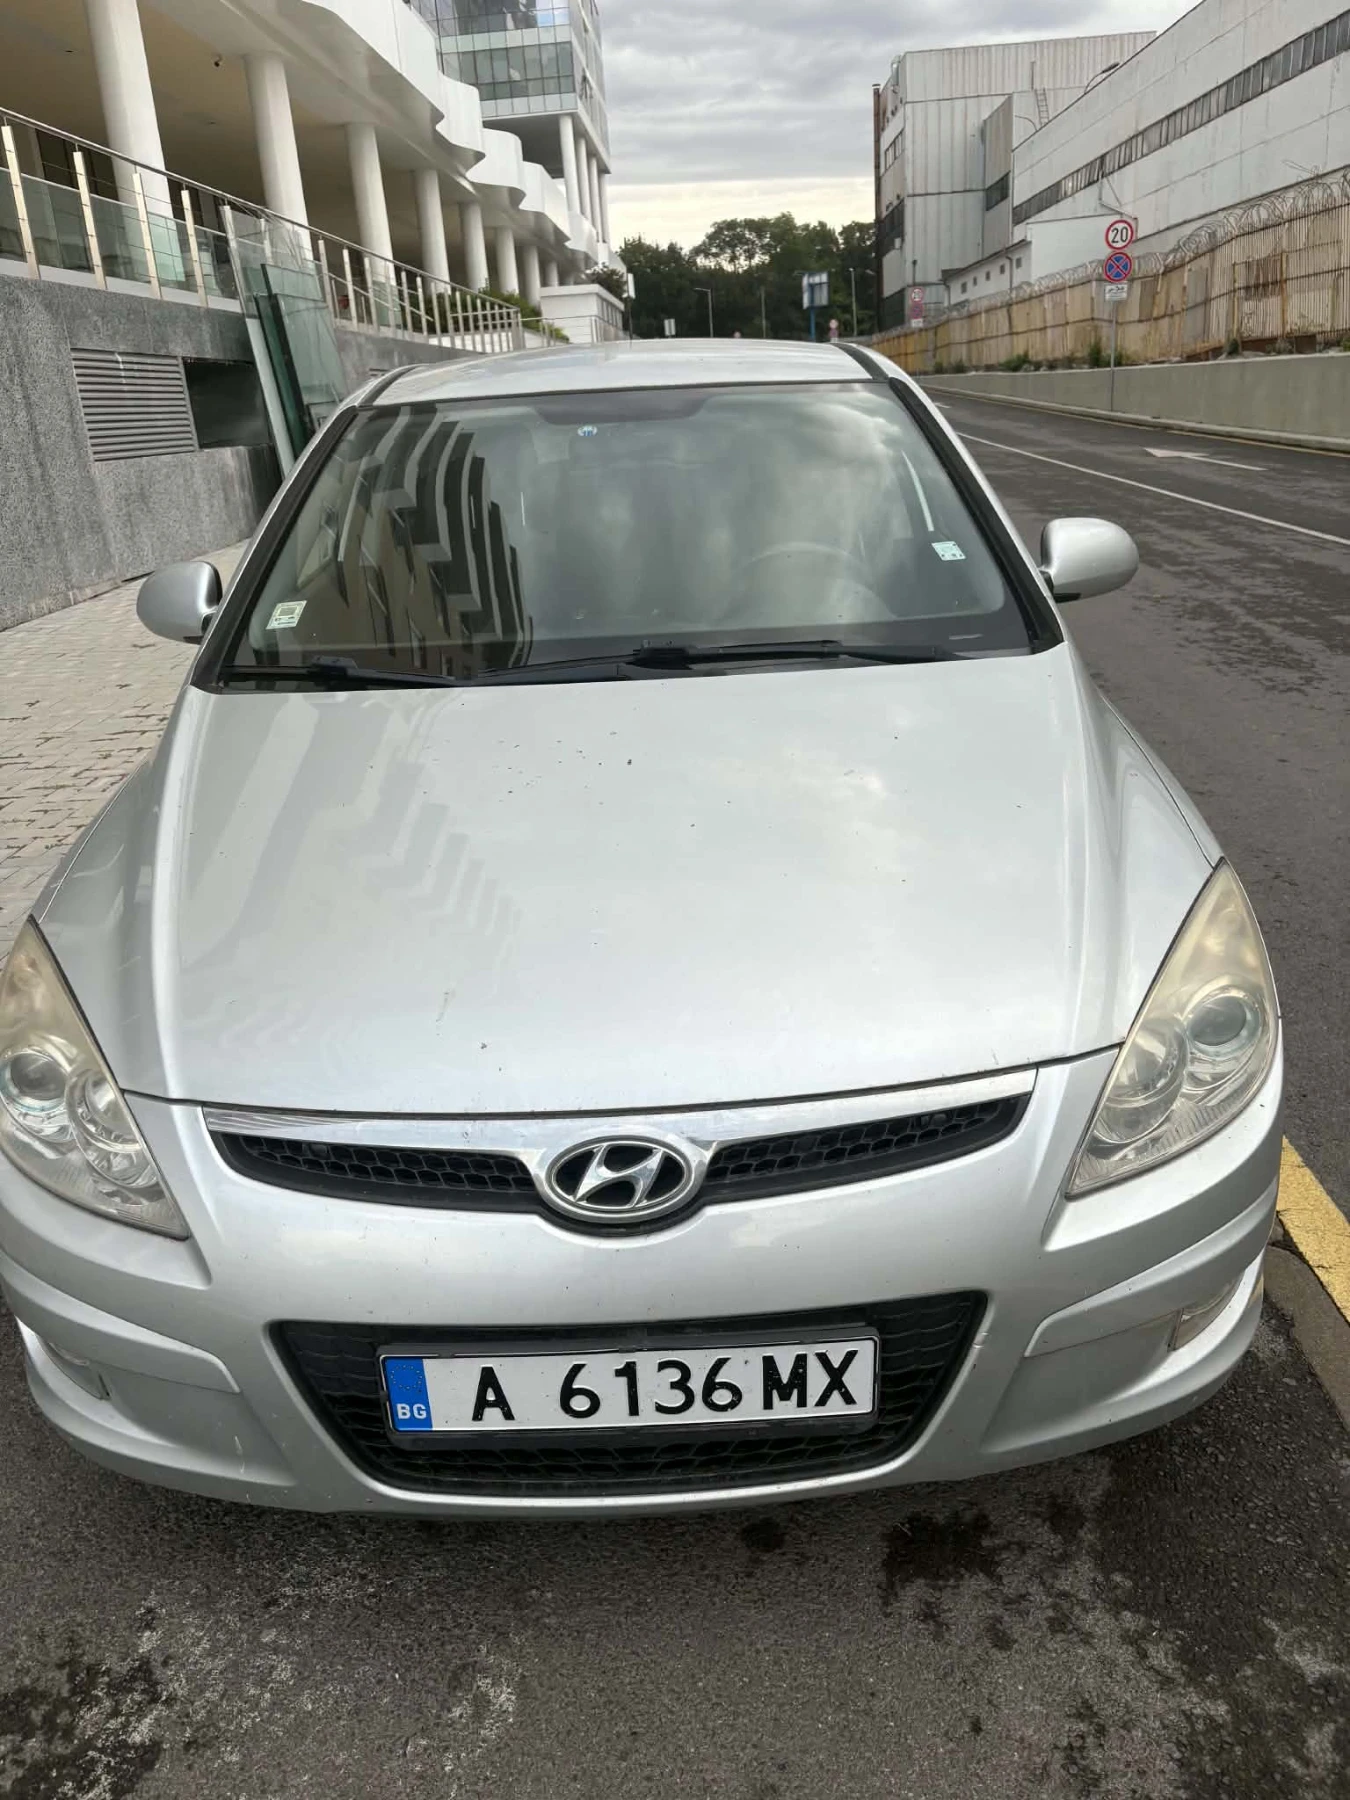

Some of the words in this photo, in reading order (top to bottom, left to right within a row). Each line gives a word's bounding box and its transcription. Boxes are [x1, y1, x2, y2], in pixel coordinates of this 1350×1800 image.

[1111, 226, 1129, 244] 20
[471, 1366, 515, 1422] A
[559, 1357, 743, 1419] 6136
[761, 1349, 859, 1411] MX
[396, 1403, 427, 1420] BG
